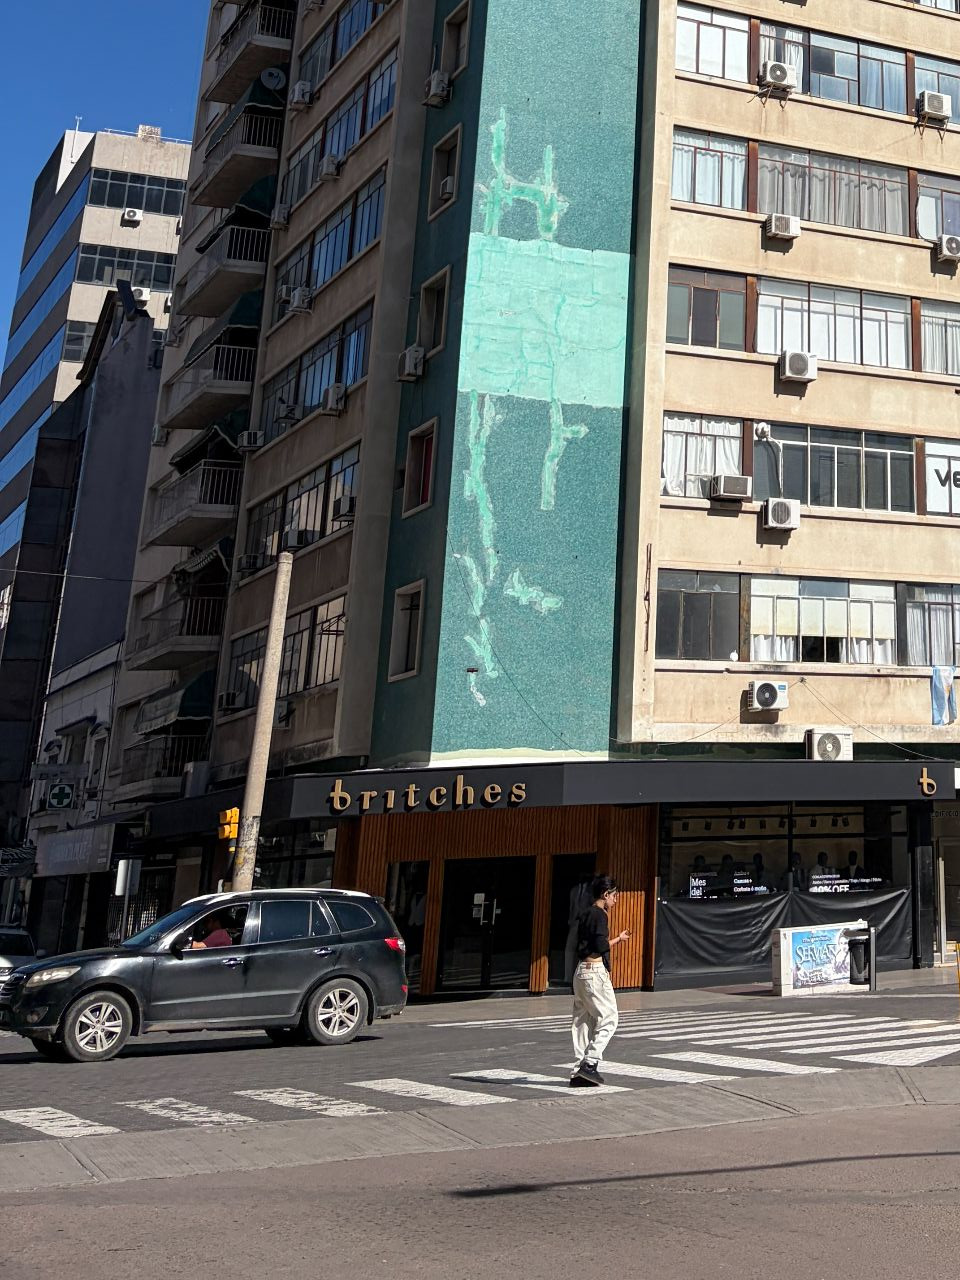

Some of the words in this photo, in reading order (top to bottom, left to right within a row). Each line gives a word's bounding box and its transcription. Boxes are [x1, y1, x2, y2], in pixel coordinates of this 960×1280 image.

[329, 774, 527, 810] britches
[691, 878, 707, 887] Mes
[691, 887, 703, 896] del
